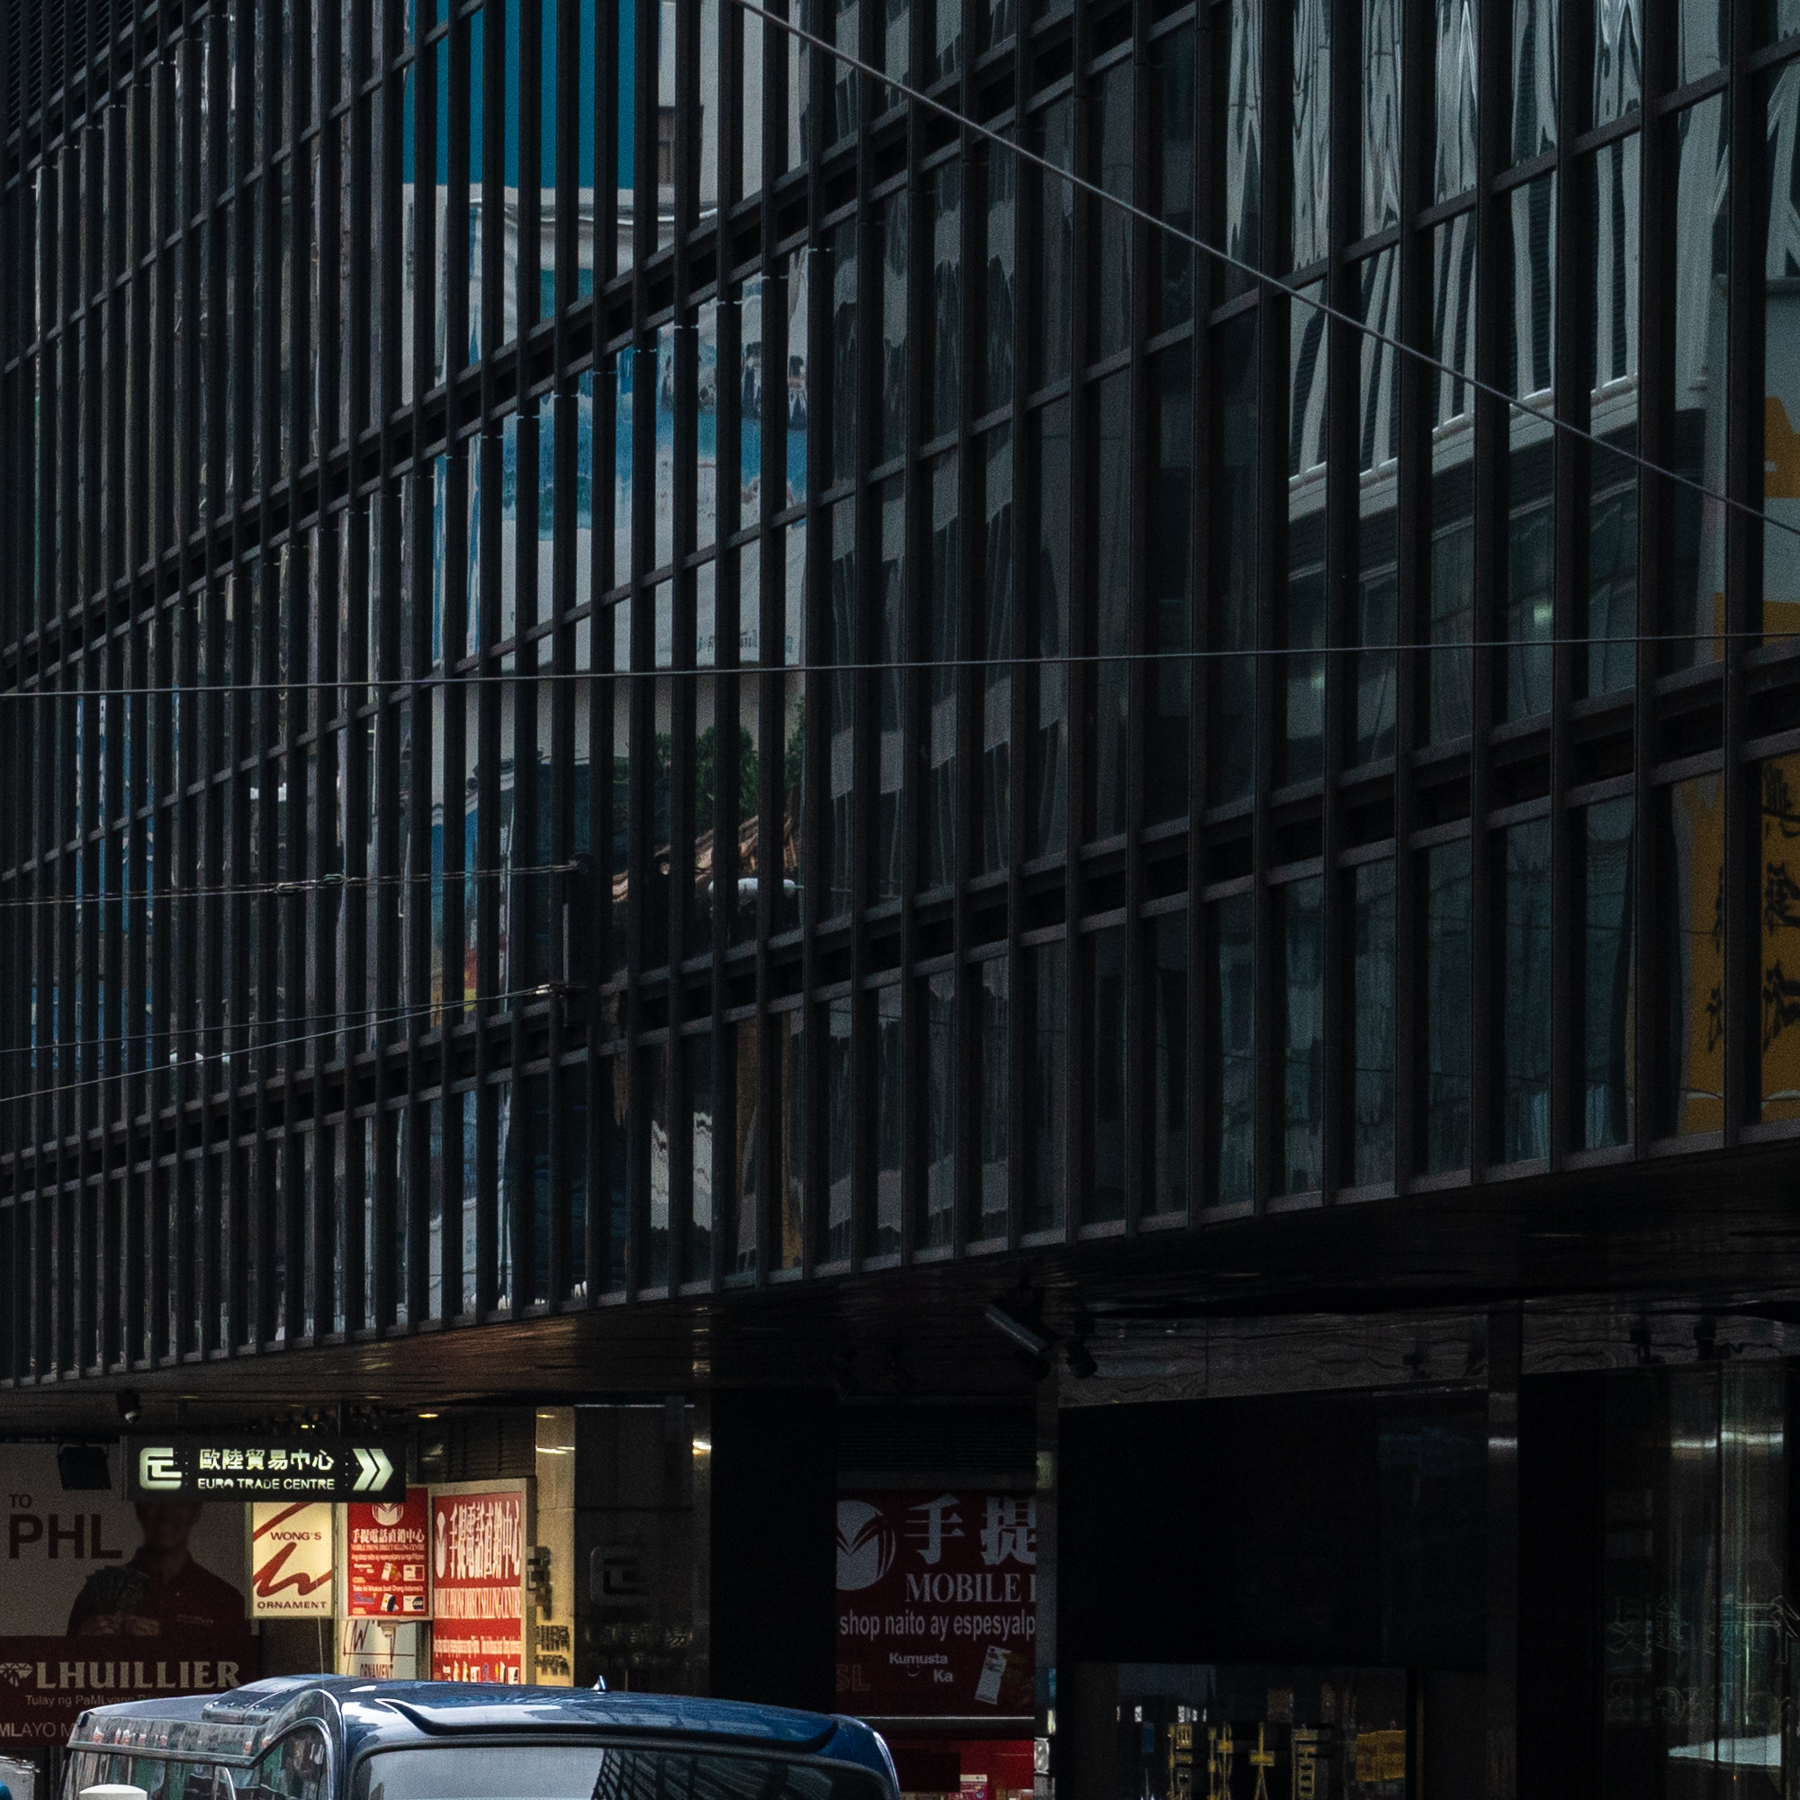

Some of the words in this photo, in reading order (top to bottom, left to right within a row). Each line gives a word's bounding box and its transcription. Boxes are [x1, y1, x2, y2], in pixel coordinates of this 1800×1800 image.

[199, 1447, 334, 1472] 歐陸貿易中心
[236, 1478, 280, 1491] TRADE
[283, 1478, 335, 1491] CENTRE
[9, 1494, 32, 1509] TO
[9, 1520, 123, 1560] PHL
[270, 1530, 322, 1542] WONG'S
[905, 1573, 1022, 1603] MOBILE
[256, 1601, 328, 1610] ORNAMENT
[839, 1609, 880, 1642] shop
[885, 1609, 925, 1635] naito
[930, 1615, 949, 1642] ay
[889, 1652, 949, 1665] Kumusta
[37, 1661, 242, 1690] LHUILLIER
[933, 1669, 954, 1683] Ka
[25, 1694, 55, 1708] Tulay
[58, 1697, 73, 1708] ng
